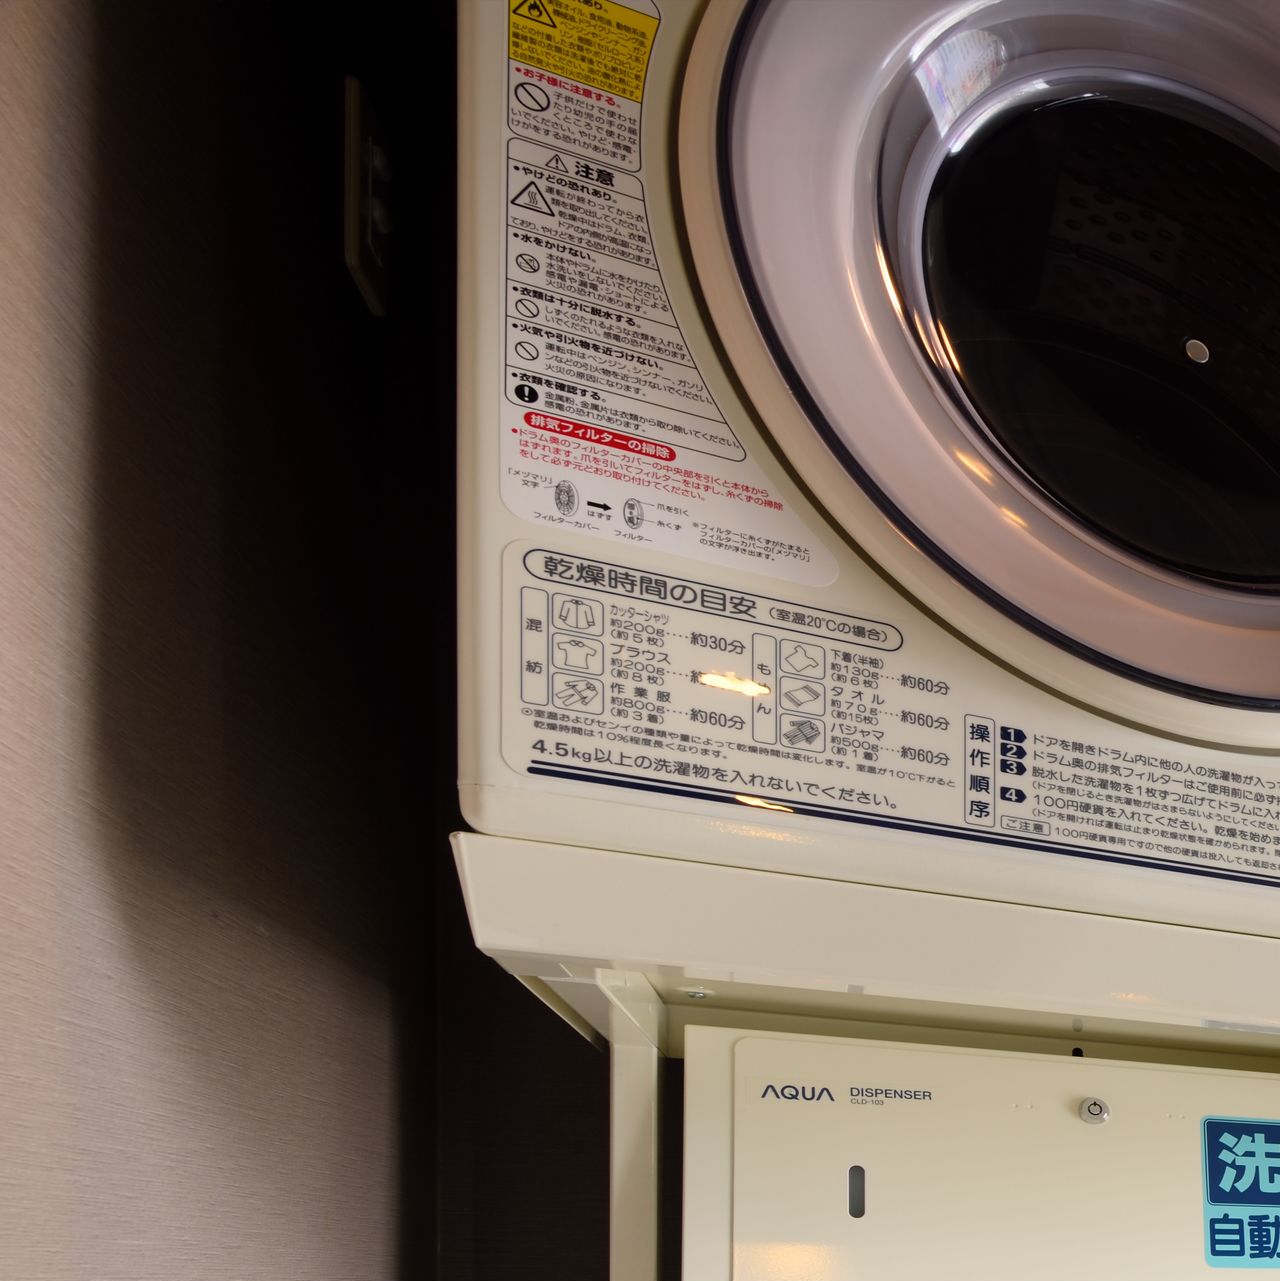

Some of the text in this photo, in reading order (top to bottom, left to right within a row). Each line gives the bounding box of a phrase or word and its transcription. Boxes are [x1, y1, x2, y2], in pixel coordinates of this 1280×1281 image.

[522, 68, 621, 108] お子様に注意する。
[553, 91, 638, 126] 子供だけで使わせ
[511, 118, 633, 164] けがをする恐れがあります。
[553, 112, 637, 145] くところで使わな
[522, 166, 618, 203] やけどの恐れあり。
[574, 161, 615, 187] 注意
[545, 185, 645, 224] 運転が終わってから衣
[521, 233, 597, 262] 水をかけない。
[545, 262, 667, 304] 水洗いをしないでください。
[545, 279, 648, 315] 火災の恐れがあります。
[520, 287, 642, 329] 衣類は十分に脱水する。
[520, 323, 664, 371] 火気や引火物を近づけない。
[519, 372, 607, 403] 衣類を確認する。
[544, 364, 647, 397] 火災の原因になります。
[544, 400, 647, 433] 感電の恐れがあります。
[529, 413, 671, 459] 排気フィルターの掃除
[518, 428, 770, 498] ドラム奥のフィルターカバーの中央部を引くと本体から
[519, 449, 706, 502] をして必ず元どおり取り付けてください。
[521, 480, 540, 489] 文字
[533, 512, 601, 531] フィルターカバー
[587, 510, 612, 521] はずす
[657, 520, 682, 531] 糸くず
[614, 529, 653, 543] フィルター
[543, 555, 758, 619] 乾燥時間の目安
[609, 603, 670, 626] カッターシャツ
[609, 618, 746, 656] 約200g 約30分
[609, 643, 671, 666] ブラウス
[609, 656, 666, 677] 約200g
[830, 648, 885, 671] 下着(半袖)
[830, 661, 951, 697] 約130g 約60分
[830, 685, 886, 707] タオル
[689, 707, 746, 732] 約60分
[829, 721, 886, 742] パジャマ
[900, 708, 951, 732] 約60分
[900, 744, 951, 768] 約60分
[969, 722, 991, 819] 操作順序
[531, 738, 901, 811] 4.5kg以上の洗濯物を入れないでください。
[1006, 818, 1044, 834] ご注意
[761, 1084, 933, 1102] AQUA DISPENSER
